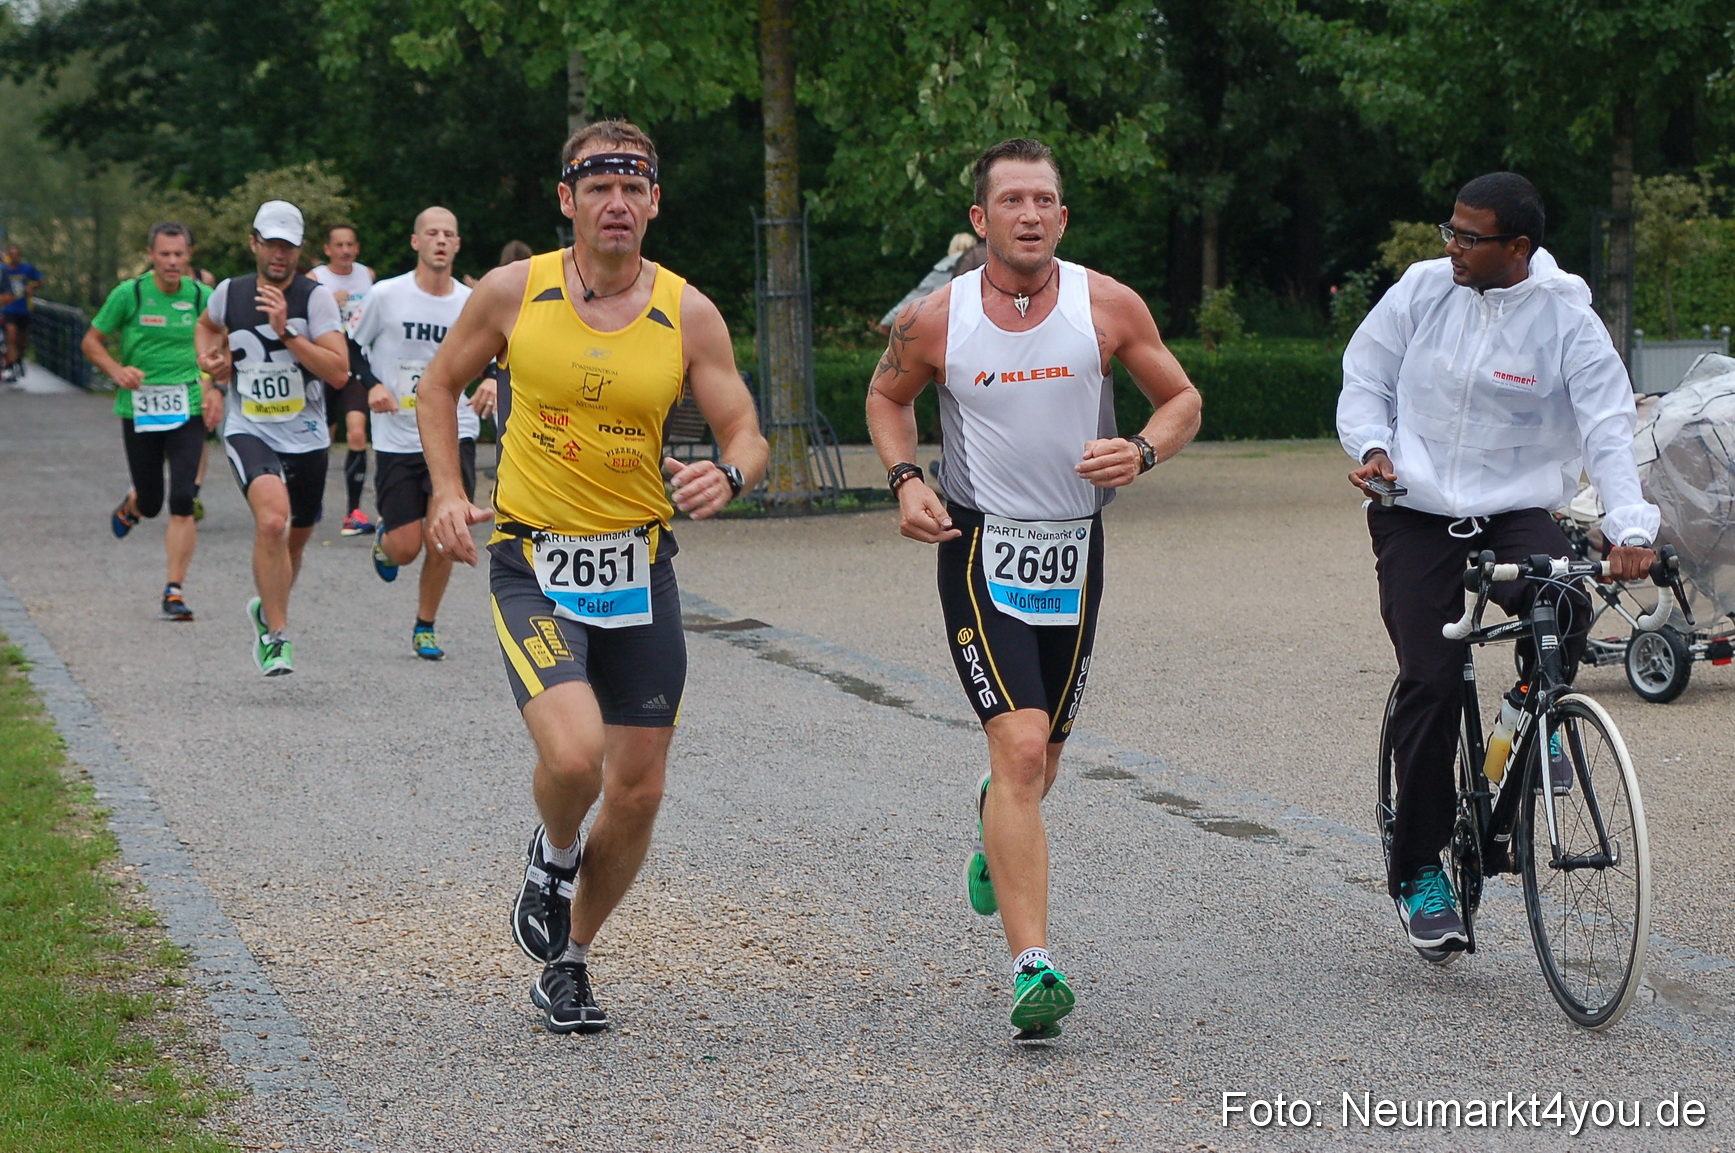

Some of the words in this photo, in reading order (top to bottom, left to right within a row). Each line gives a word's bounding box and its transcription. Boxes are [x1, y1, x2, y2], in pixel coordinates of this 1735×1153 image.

[1001, 366, 1075, 383] KLEBL
[1493, 371, 1537, 386] memmert
[252, 376, 290, 399] 460
[138, 395, 182, 412] 3136
[576, 401, 608, 412] NEUMARKT
[539, 411, 569, 427] Seidl
[613, 458, 640, 467] ELIO
[538, 532, 576, 543] ARTL
[580, 530, 631, 543] Neumarkt
[986, 524, 1024, 538] PARTL
[1028, 529, 1074, 541] Neumarkt
[546, 543, 634, 587] 2651
[995, 542, 1079, 585] 2699
[578, 597, 615, 613] Peter
[1006, 590, 1061, 613] Wolfgang
[962, 644, 998, 709] SKINS
